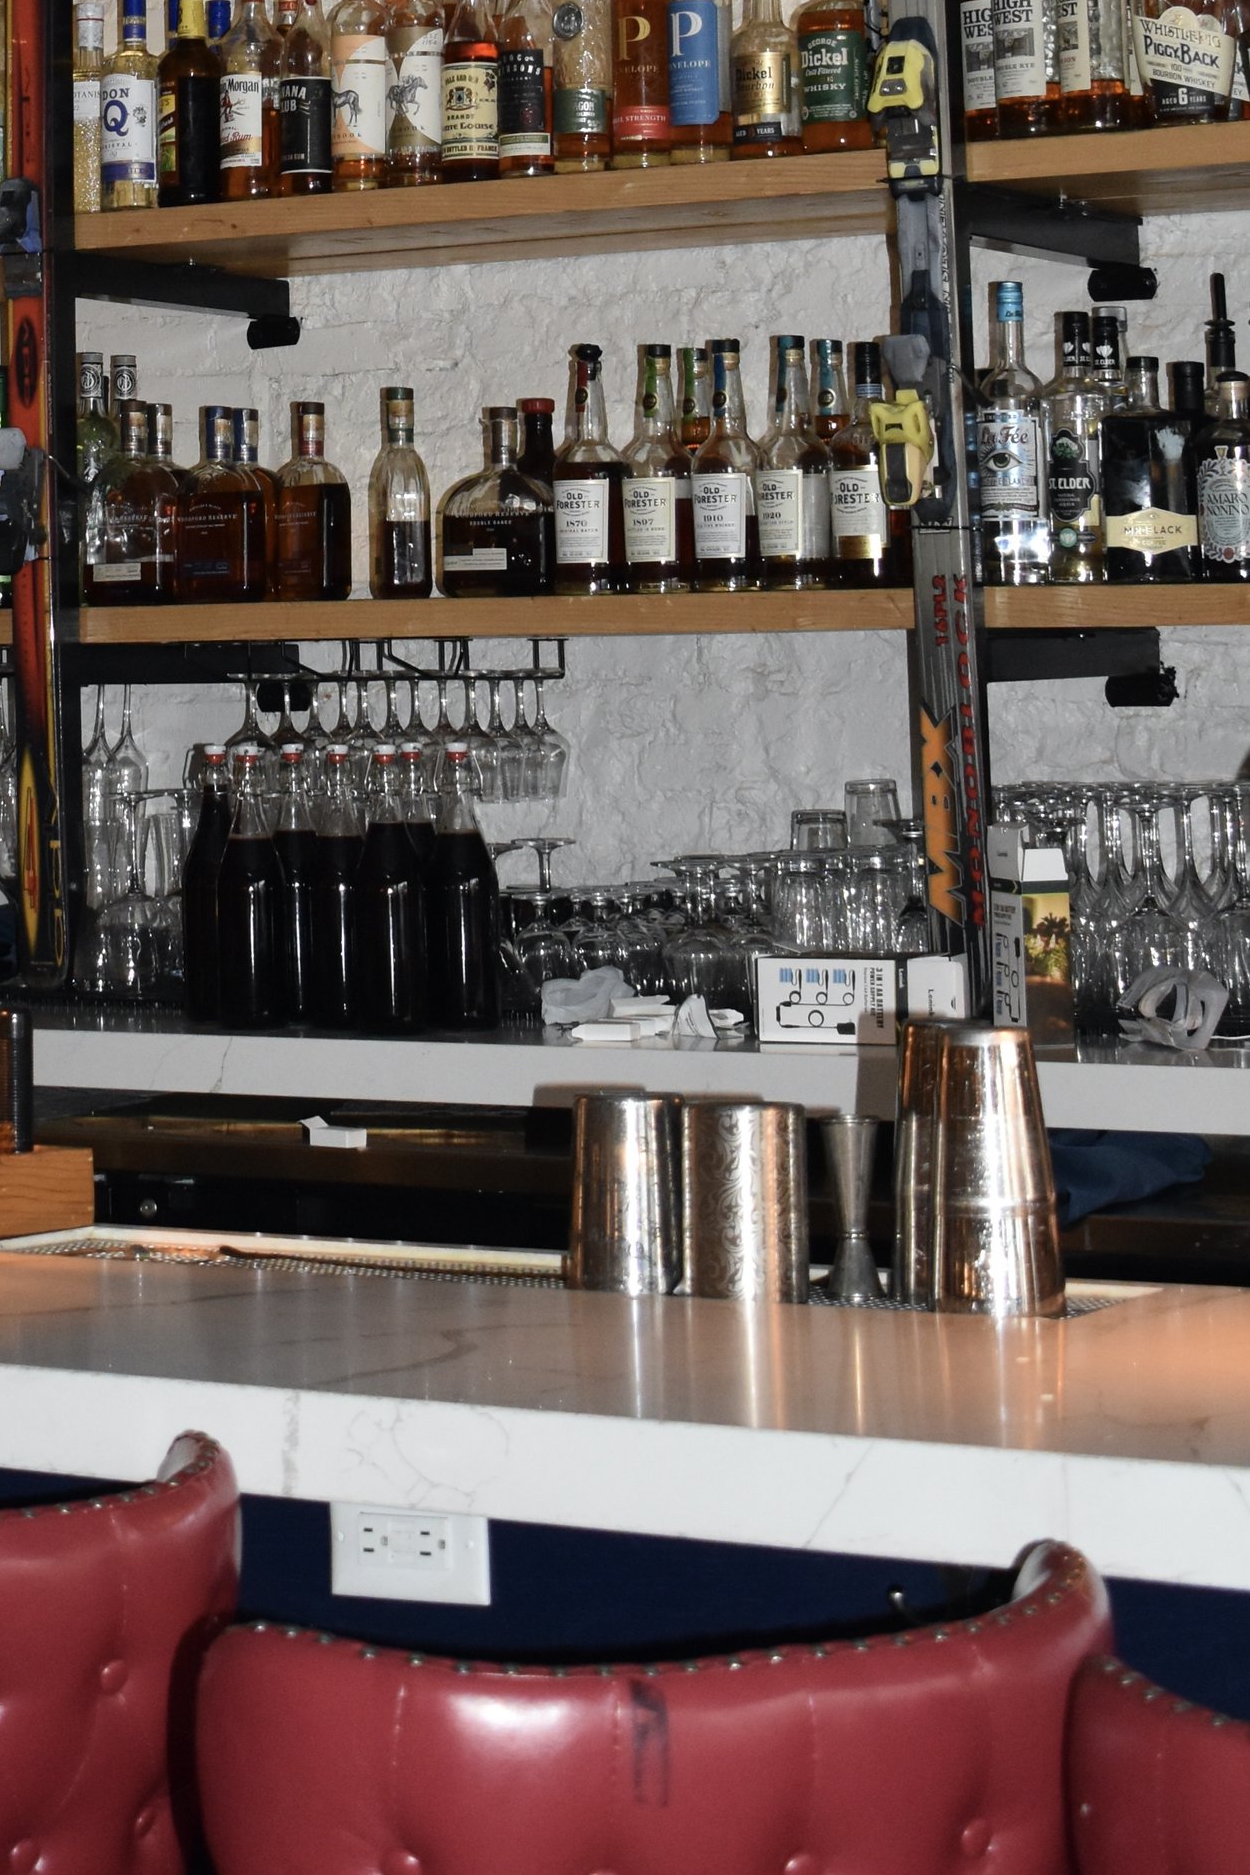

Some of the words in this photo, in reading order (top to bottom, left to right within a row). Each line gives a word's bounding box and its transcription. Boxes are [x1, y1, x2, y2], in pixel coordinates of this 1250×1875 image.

[962, 7, 993, 25] HIG
[993, 9, 1034, 26] WEST
[670, 10, 703, 56] P
[963, 23, 994, 39] WES
[617, 15, 651, 61] P
[807, 38, 838, 48] GEORGE
[801, 47, 849, 67] Dickel
[1170, 63, 1182, 72] 100
[735, 66, 773, 81] Dickel
[1152, 68, 1183, 81] BOURBON
[1183, 76, 1216, 89] WHISKEY
[228, 78, 260, 95] Morgan
[802, 82, 848, 93] WHISKY
[102, 87, 130, 102] DON
[1161, 96, 1178, 105] AGED
[1177, 87, 1188, 105] 6
[103, 99, 130, 137] Q
[446, 113, 474, 121] BRANDY
[460, 120, 495, 131] Louise
[756, 127, 775, 135] YEARS
[232, 132, 253, 142] Rum
[477, 144, 498, 153] FRANCE
[999, 425, 1029, 444] Fée
[762, 483, 777, 492] OLD
[839, 482, 859, 493] OLD
[1058, 477, 1091, 490] ELDER
[566, 491, 583, 501] OLD
[632, 490, 650, 499] OLD
[703, 486, 720, 495] OLD
[624, 498, 667, 509] FORESTER
[694, 494, 738, 505] FORESTER
[1206, 492, 1248, 505] AMARO
[556, 500, 600, 510] FORESTER
[1206, 504, 1250, 517] NONINO
[703, 514, 724, 522] 1910
[762, 511, 781, 519] 1920
[565, 519, 588, 528] 1870
[632, 518, 654, 526] 1897
[953, 573, 985, 928] MONOBLOCK
[919, 702, 966, 927] MBX
[876, 999, 884, 1029] BATTERY
